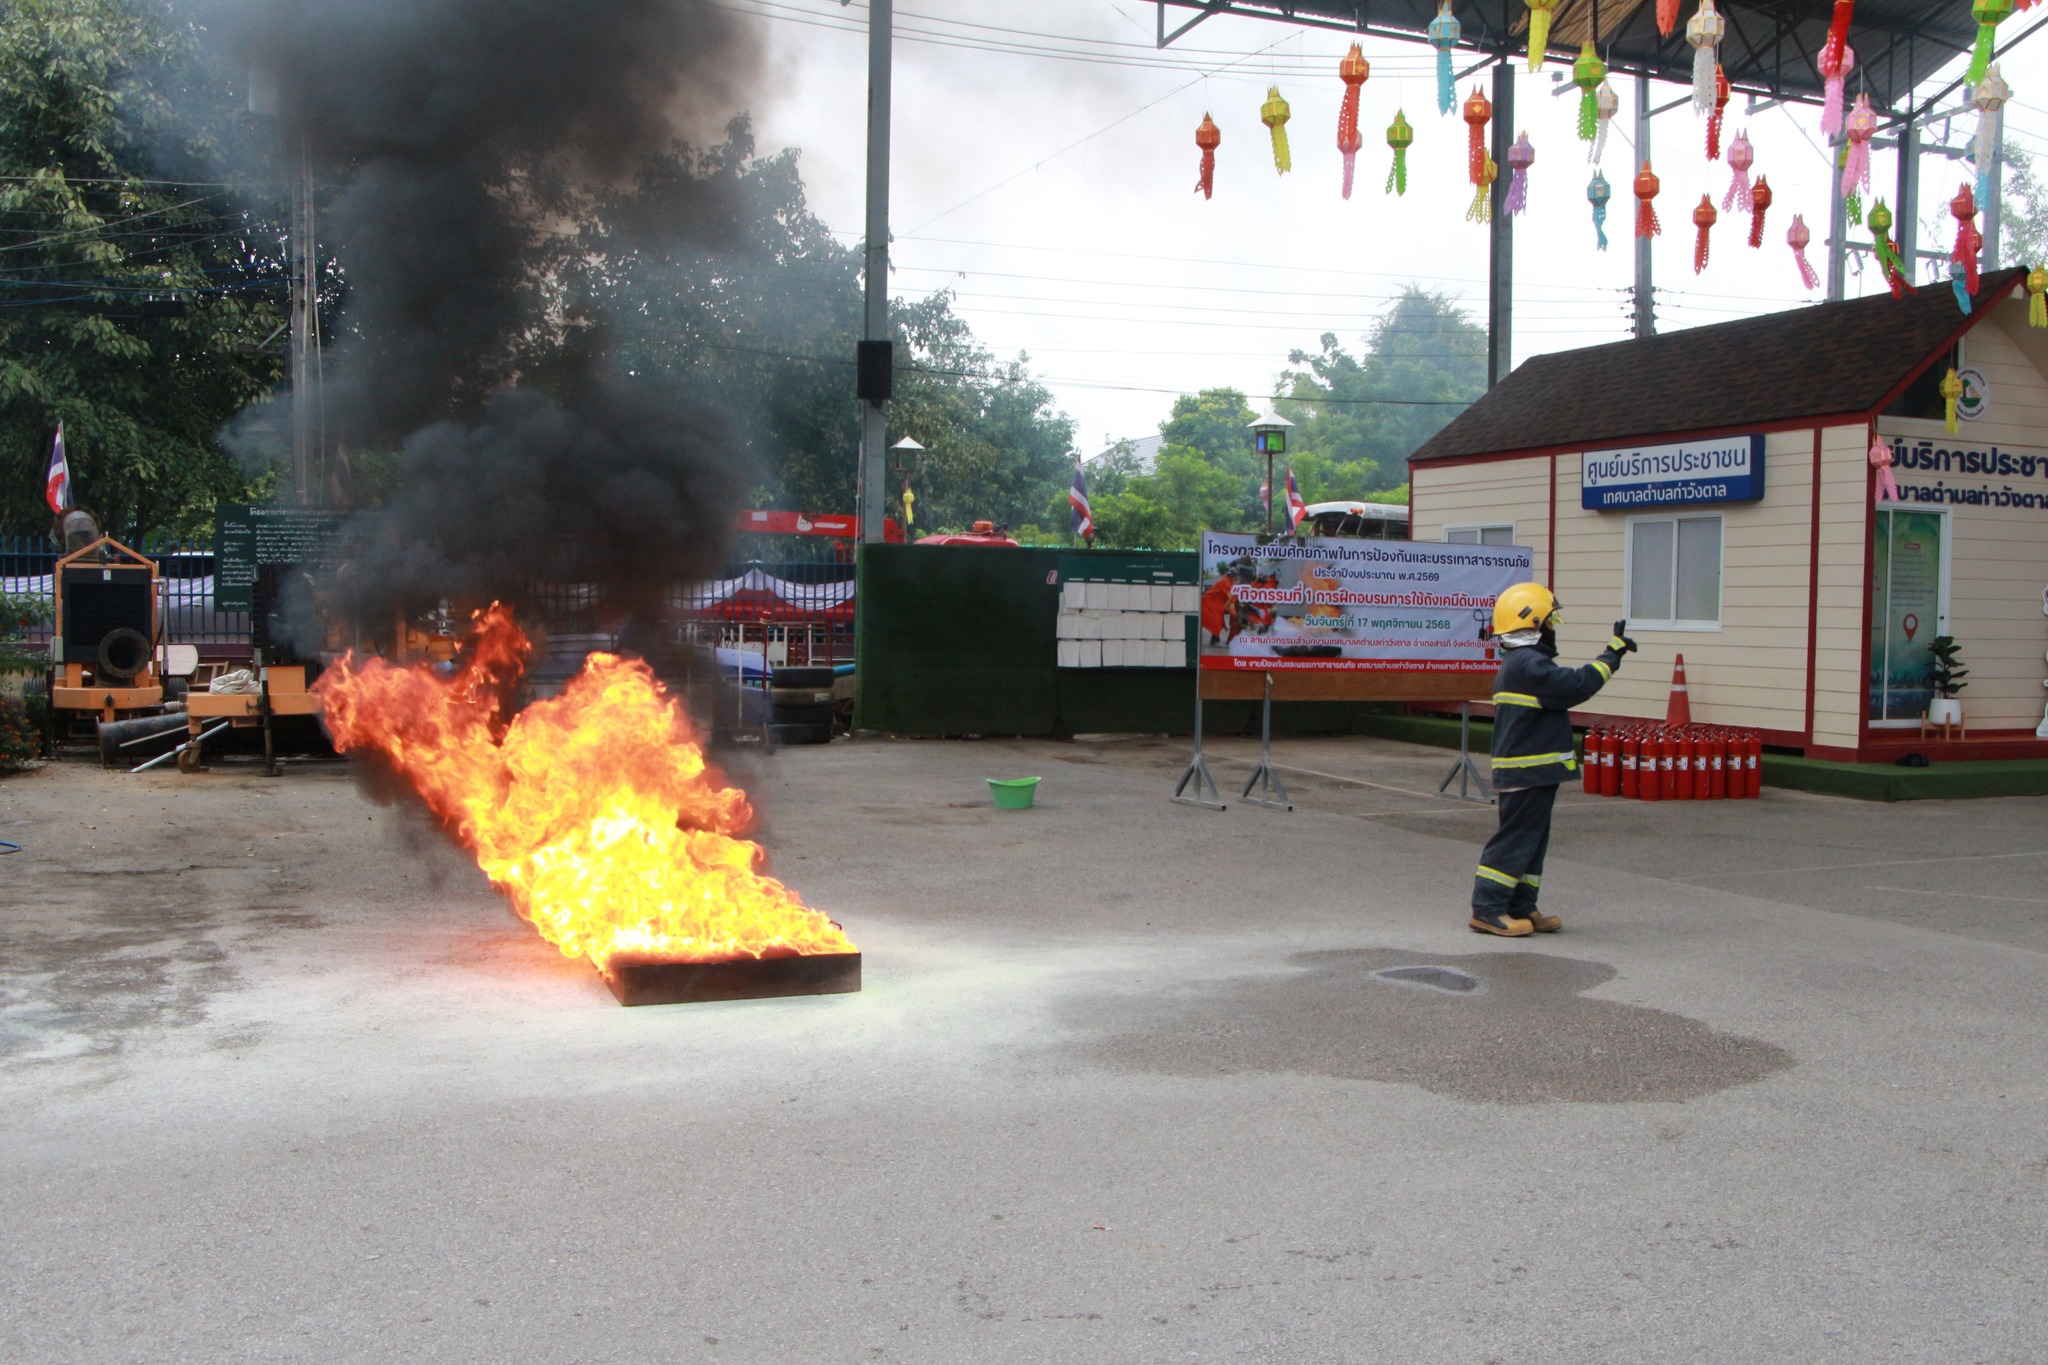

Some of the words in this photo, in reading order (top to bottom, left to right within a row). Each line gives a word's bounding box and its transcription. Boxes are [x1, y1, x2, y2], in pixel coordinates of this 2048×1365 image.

[1587, 448, 1746, 485] ศูนย์บริการประชาชน
[1603, 482, 1727, 504] เทศบาลตำบลท่าวังตาล
[1208, 540, 1530, 569] โครงการเพิ่มศักยภาพในการป้องกันและบรรเทาสาธารณภัย
[1314, 567, 1396, 581] ประจำปีงบประมาณ
[1398, 571, 1440, 582] พ.ศ.2569
[1306, 590, 1312, 602] 1
[1316, 588, 1498, 608] การฝึกอบรมการใช้ถังเคมีดับเพลิ
[1305, 614, 1344, 627] วันจันทร์
[1347, 613, 1355, 627] ที่
[1358, 618, 1368, 628] 17
[1371, 617, 1423, 630] พฤศจิกายน
[1426, 619, 1451, 630] 2568
[1234, 658, 1247, 667] โดย
